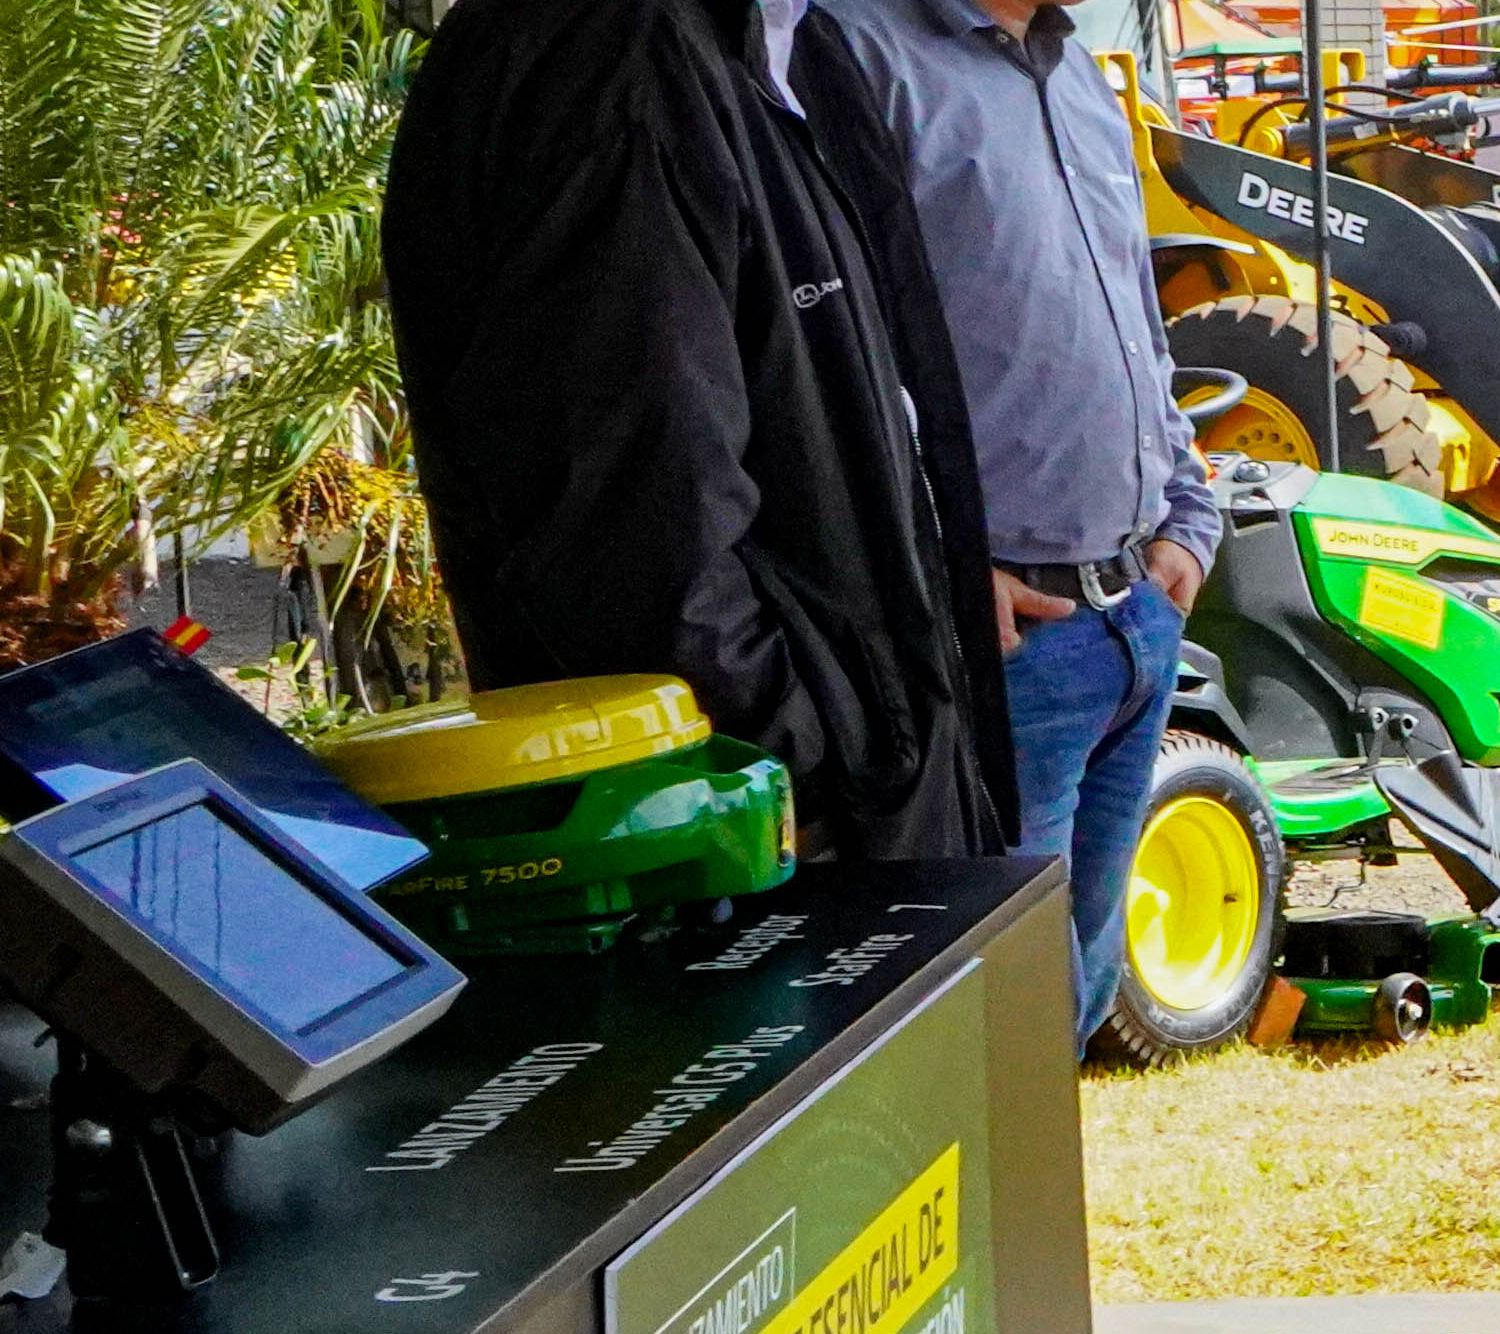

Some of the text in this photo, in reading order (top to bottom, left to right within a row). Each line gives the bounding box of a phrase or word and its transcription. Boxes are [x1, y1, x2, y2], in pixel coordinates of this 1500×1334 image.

[1237, 172, 1368, 245] DEERE
[1329, 529, 1419, 552] JOHN DEERE
[481, 858, 564, 884] 7500
[888, 903, 948, 913] 7
[685, 914, 808, 971] Receptor
[365, 1041, 603, 1172] LANZAMIENTO
[554, 1088, 728, 1172] Universal
[703, 1025, 805, 1059] Plus
[919, 1187, 944, 1271] DE
